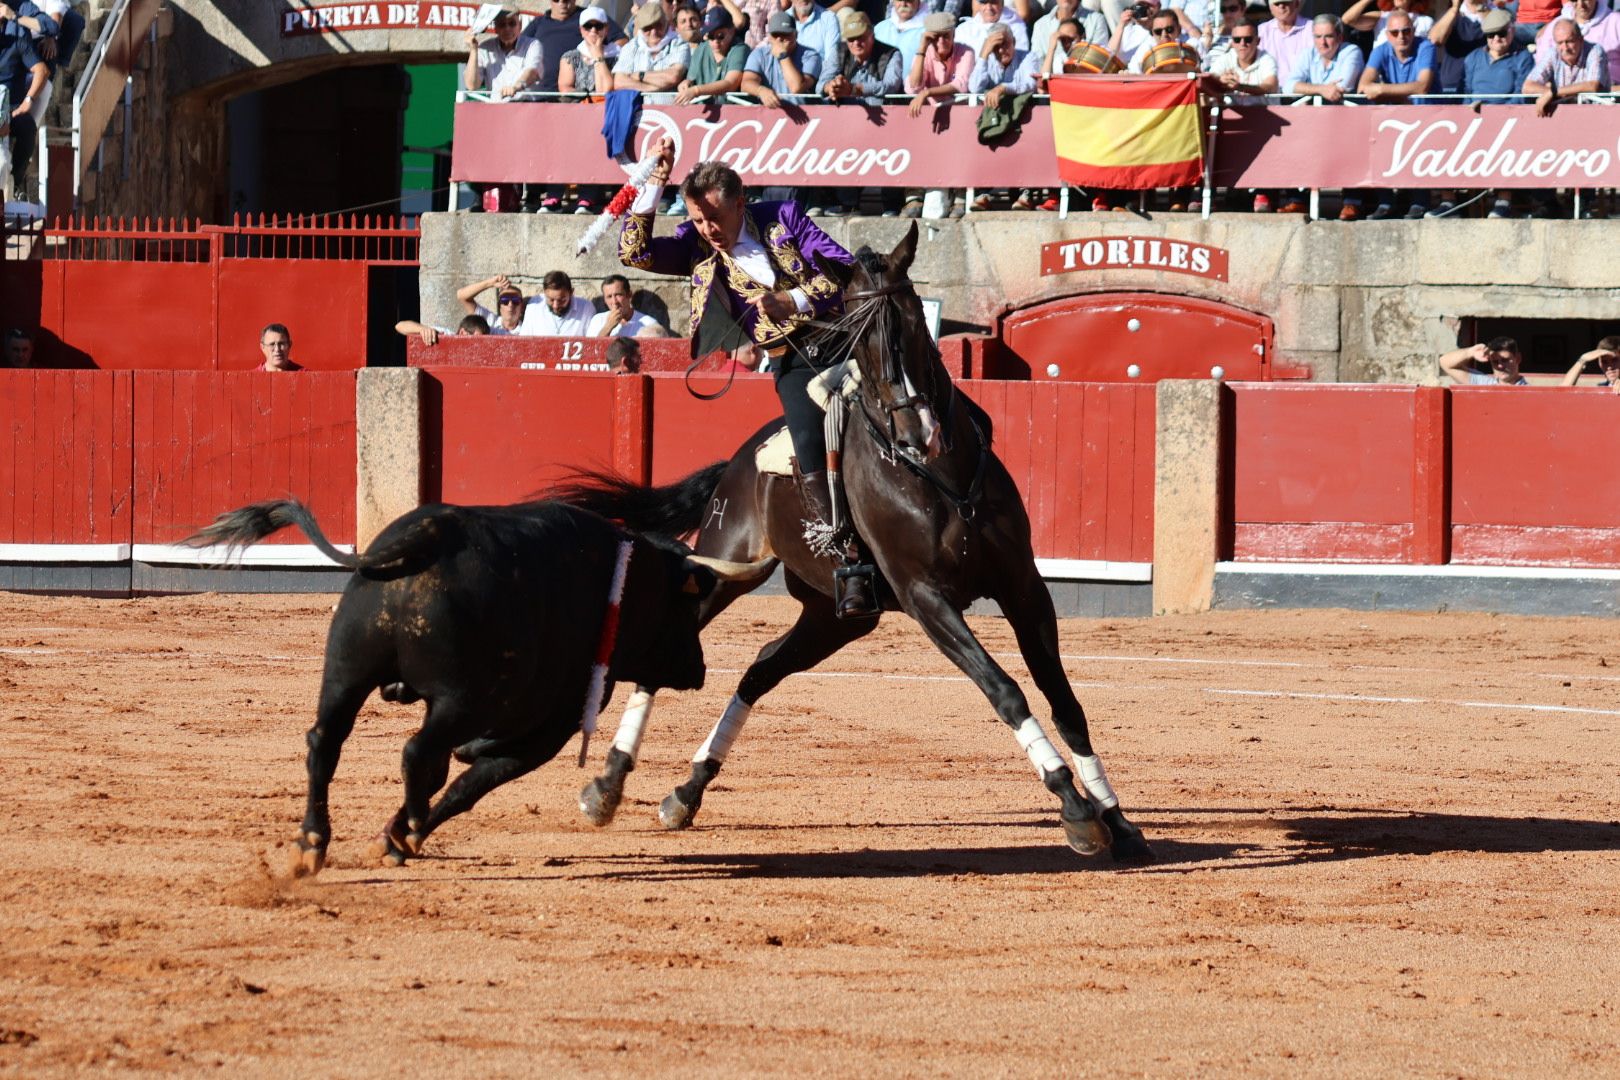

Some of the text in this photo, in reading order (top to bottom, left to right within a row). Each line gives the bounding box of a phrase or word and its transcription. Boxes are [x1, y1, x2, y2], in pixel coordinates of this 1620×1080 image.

[285, 5, 380, 31] PUERTA
[388, 4, 419, 24] DE
[686, 118, 911, 176] Valduero
[1378, 117, 1611, 178] Valduero
[1060, 240, 1211, 273] TORILES
[560, 341, 583, 360] 12
